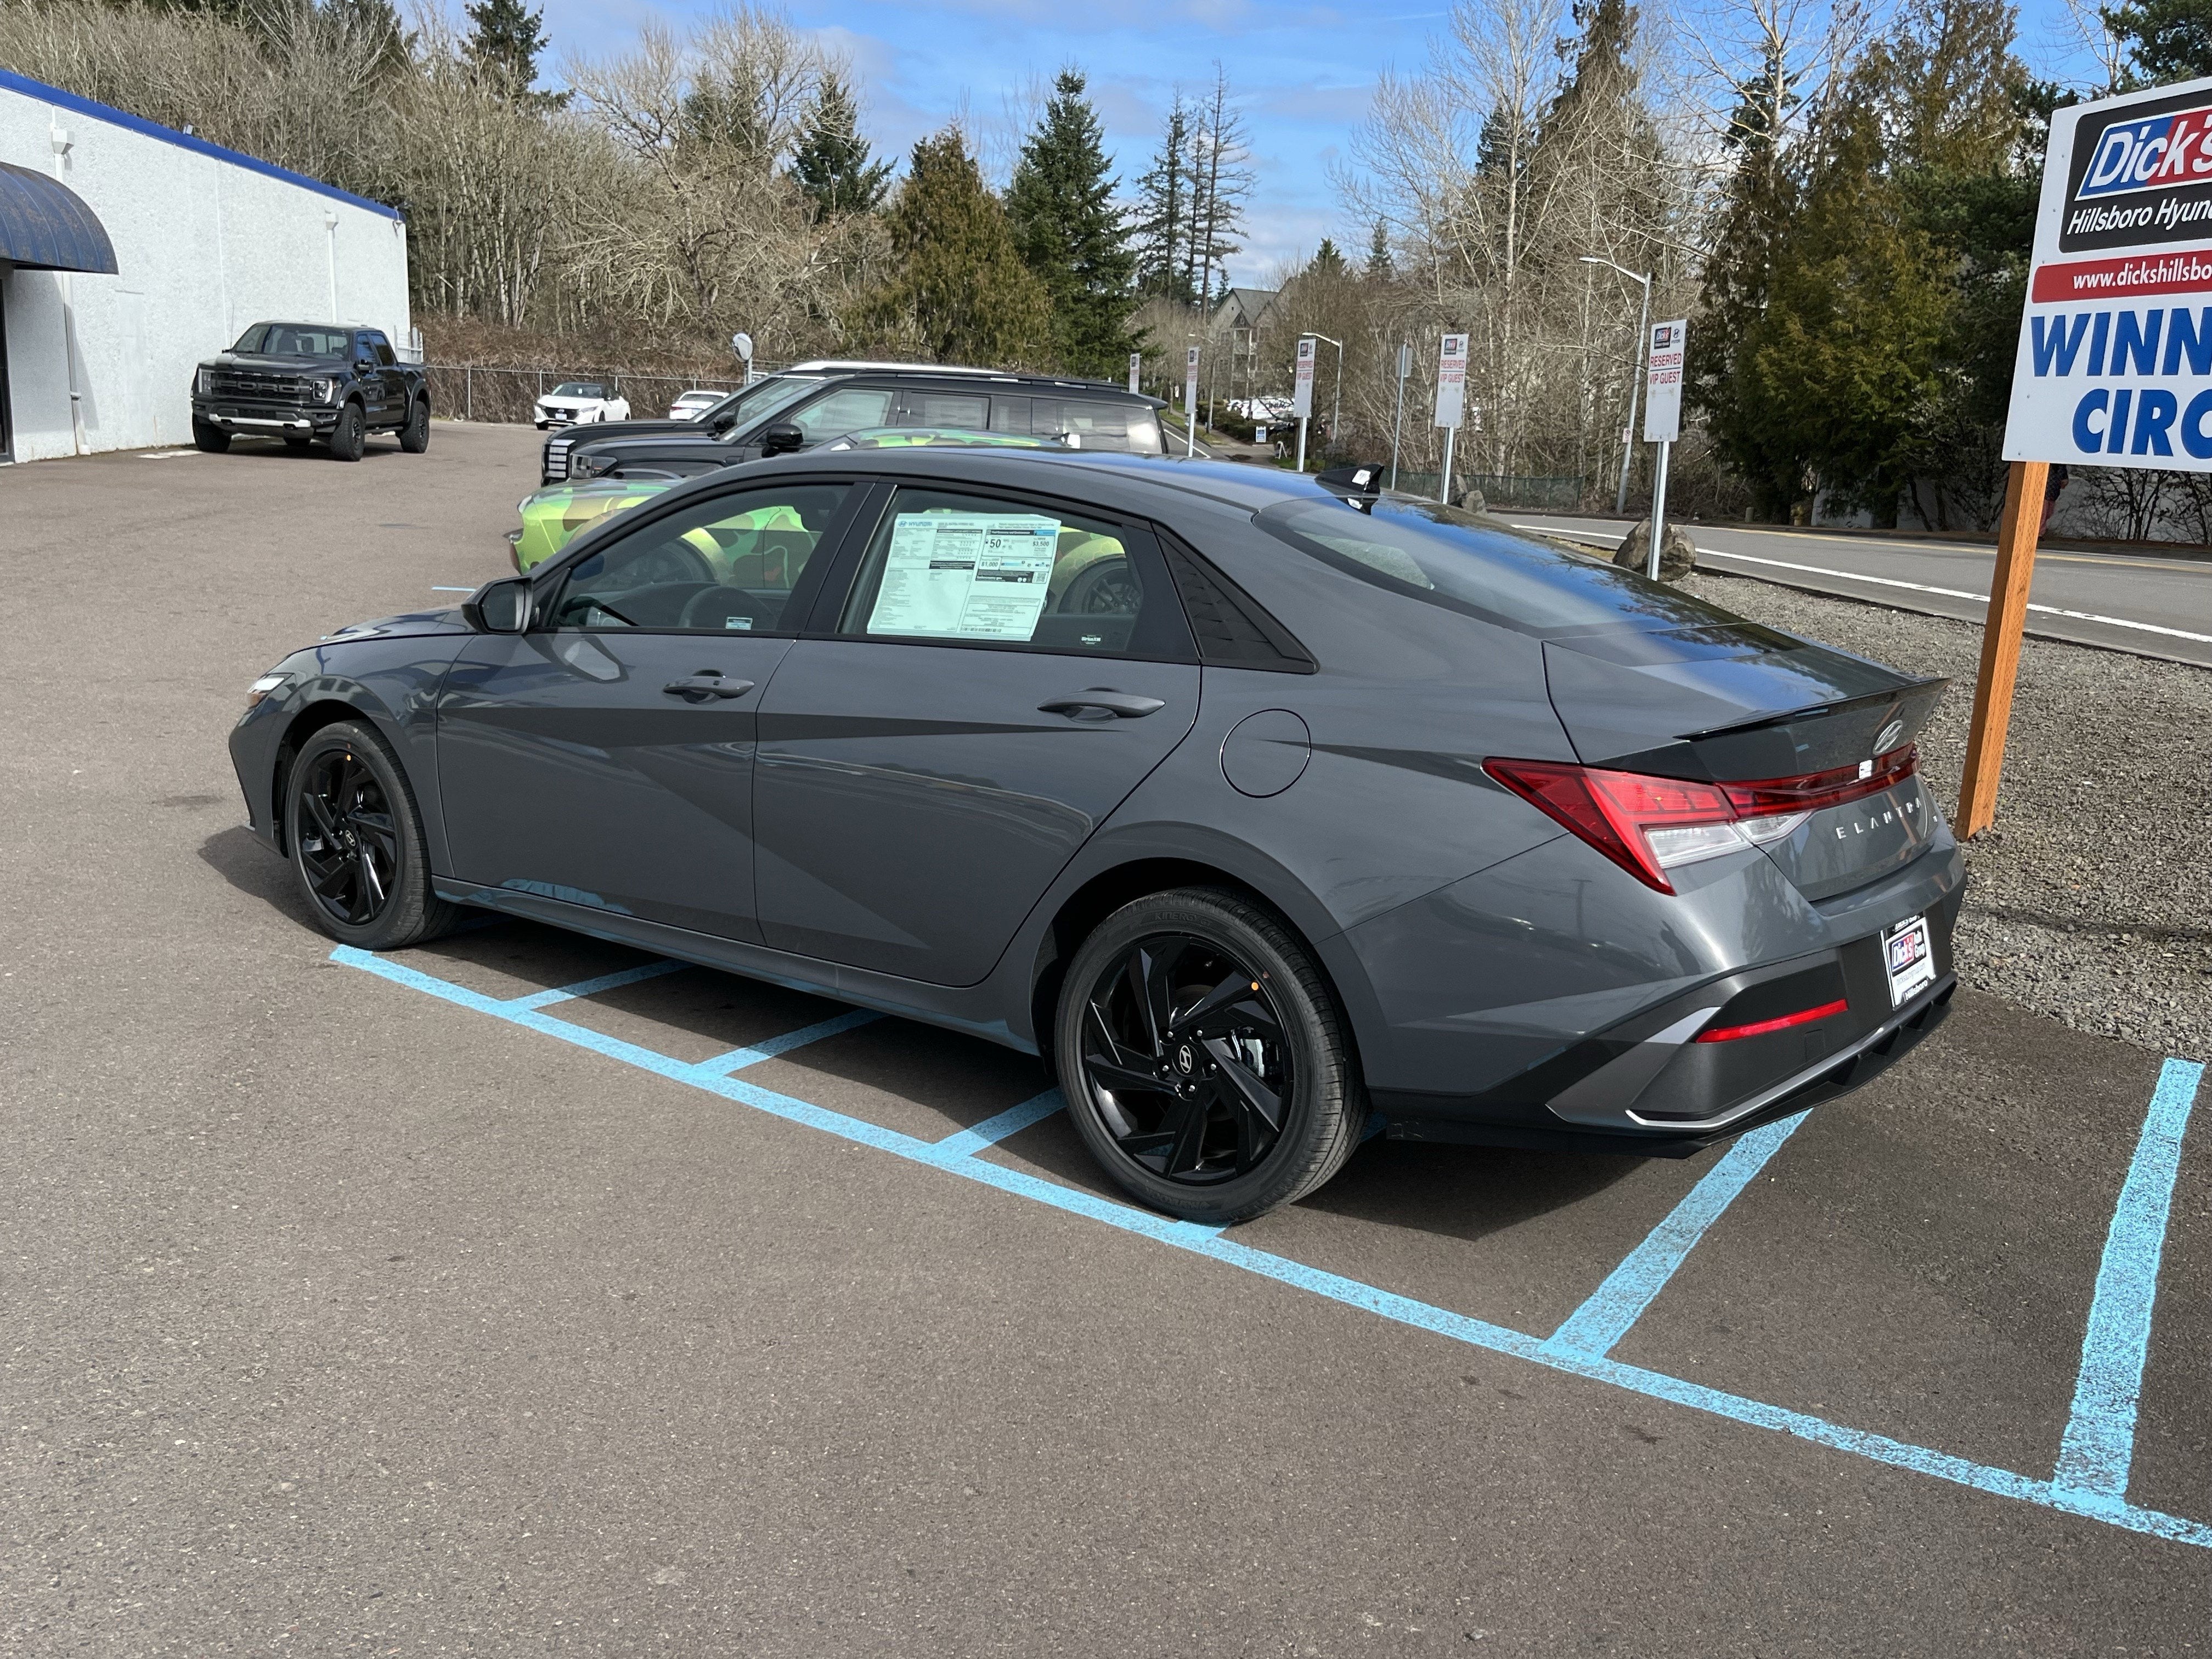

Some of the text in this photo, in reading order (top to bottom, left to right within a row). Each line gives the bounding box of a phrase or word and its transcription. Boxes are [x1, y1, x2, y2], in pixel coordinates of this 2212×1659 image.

[2088, 114, 2212, 188] Dick's
[2067, 198, 2212, 235] Hillsboro Hyun
[2073, 257, 2212, 290] www.dickshillsbo
[2030, 307, 2212, 376] WINN
[1650, 353, 1682, 368] RESERVED
[1650, 371, 1681, 385] VIP GUEST
[217, 380, 299, 393] FORD
[2072, 389, 2212, 459] CIRC
[989, 539, 1001, 548] 50
[1836, 797, 1921, 839] ELANTRA
